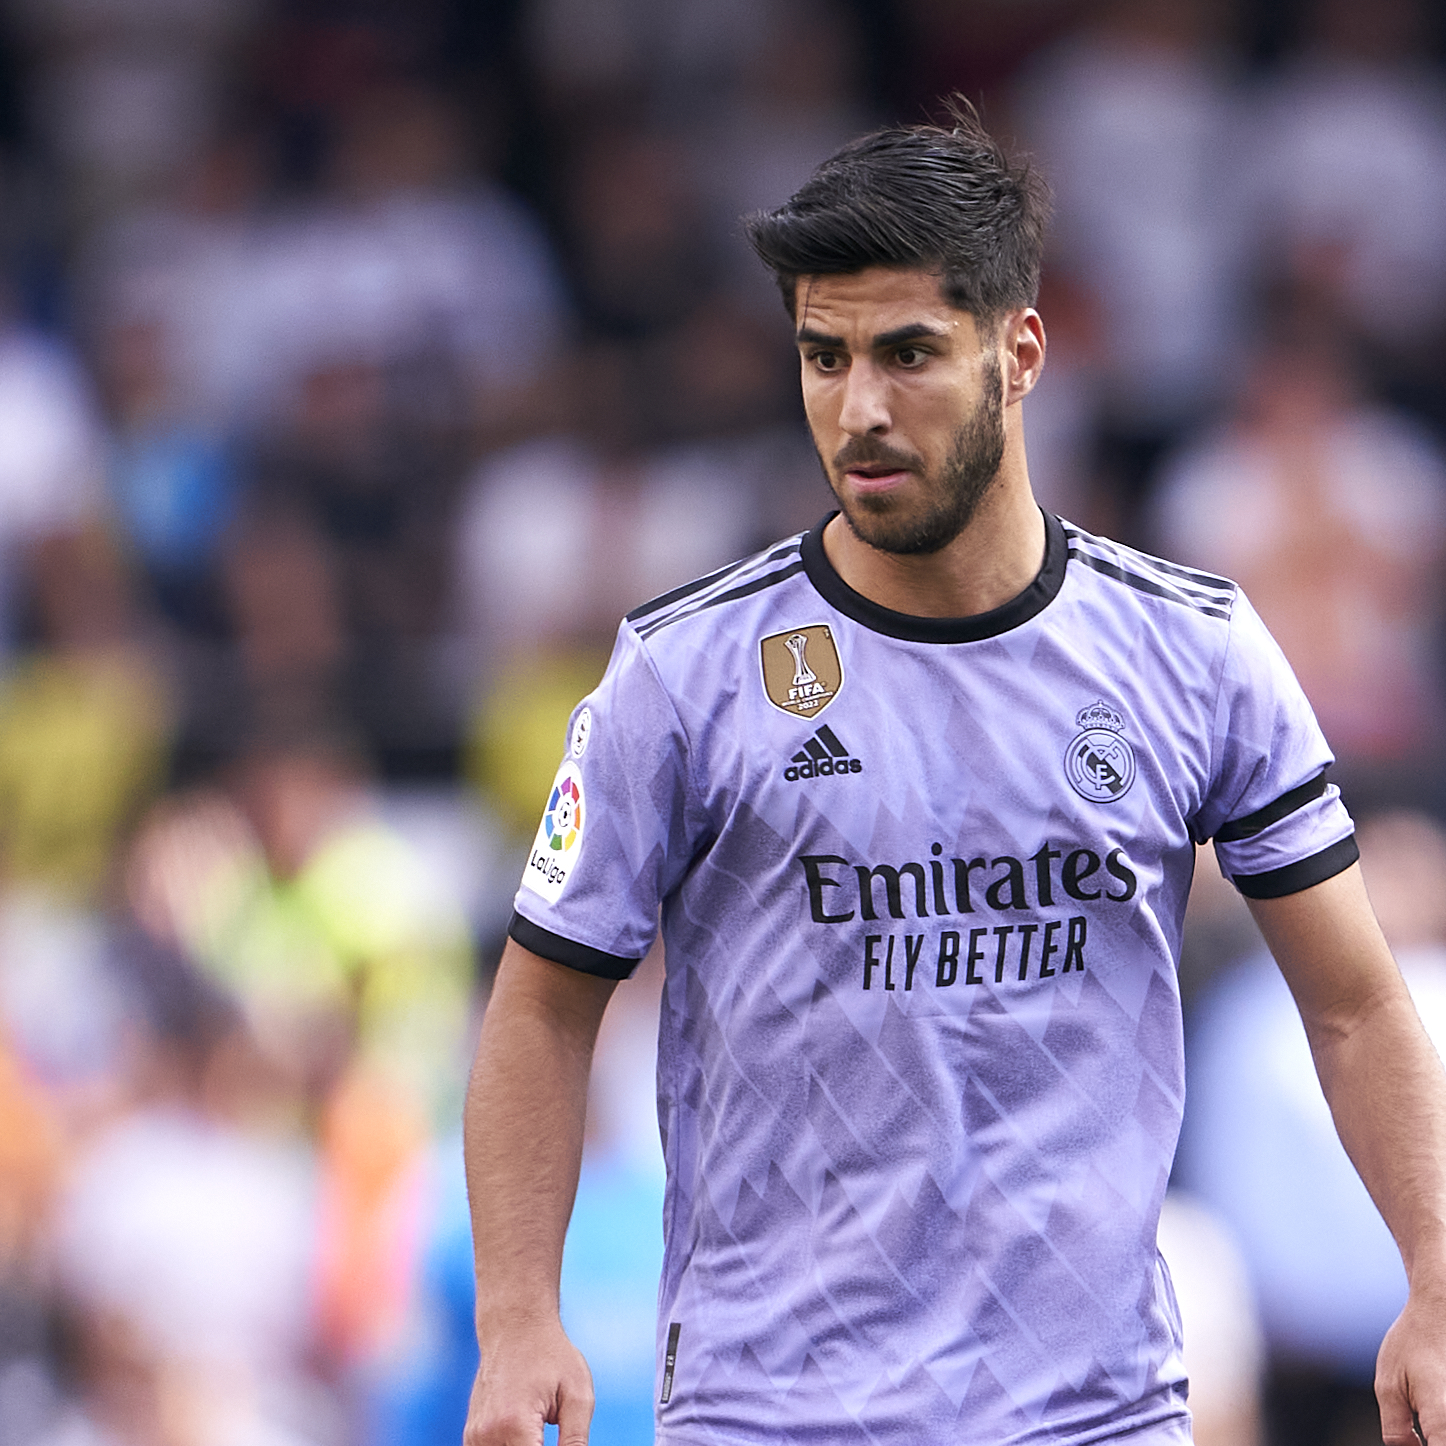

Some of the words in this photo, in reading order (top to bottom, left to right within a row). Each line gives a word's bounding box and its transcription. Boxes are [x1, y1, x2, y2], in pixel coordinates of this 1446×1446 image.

[787, 682, 825, 700] FIFA
[783, 756, 863, 782] adidas
[530, 849, 566, 884] LaLiga
[797, 841, 1138, 924] Emirates
[862, 934, 924, 991] FLY
[935, 916, 1088, 988] BETTER
